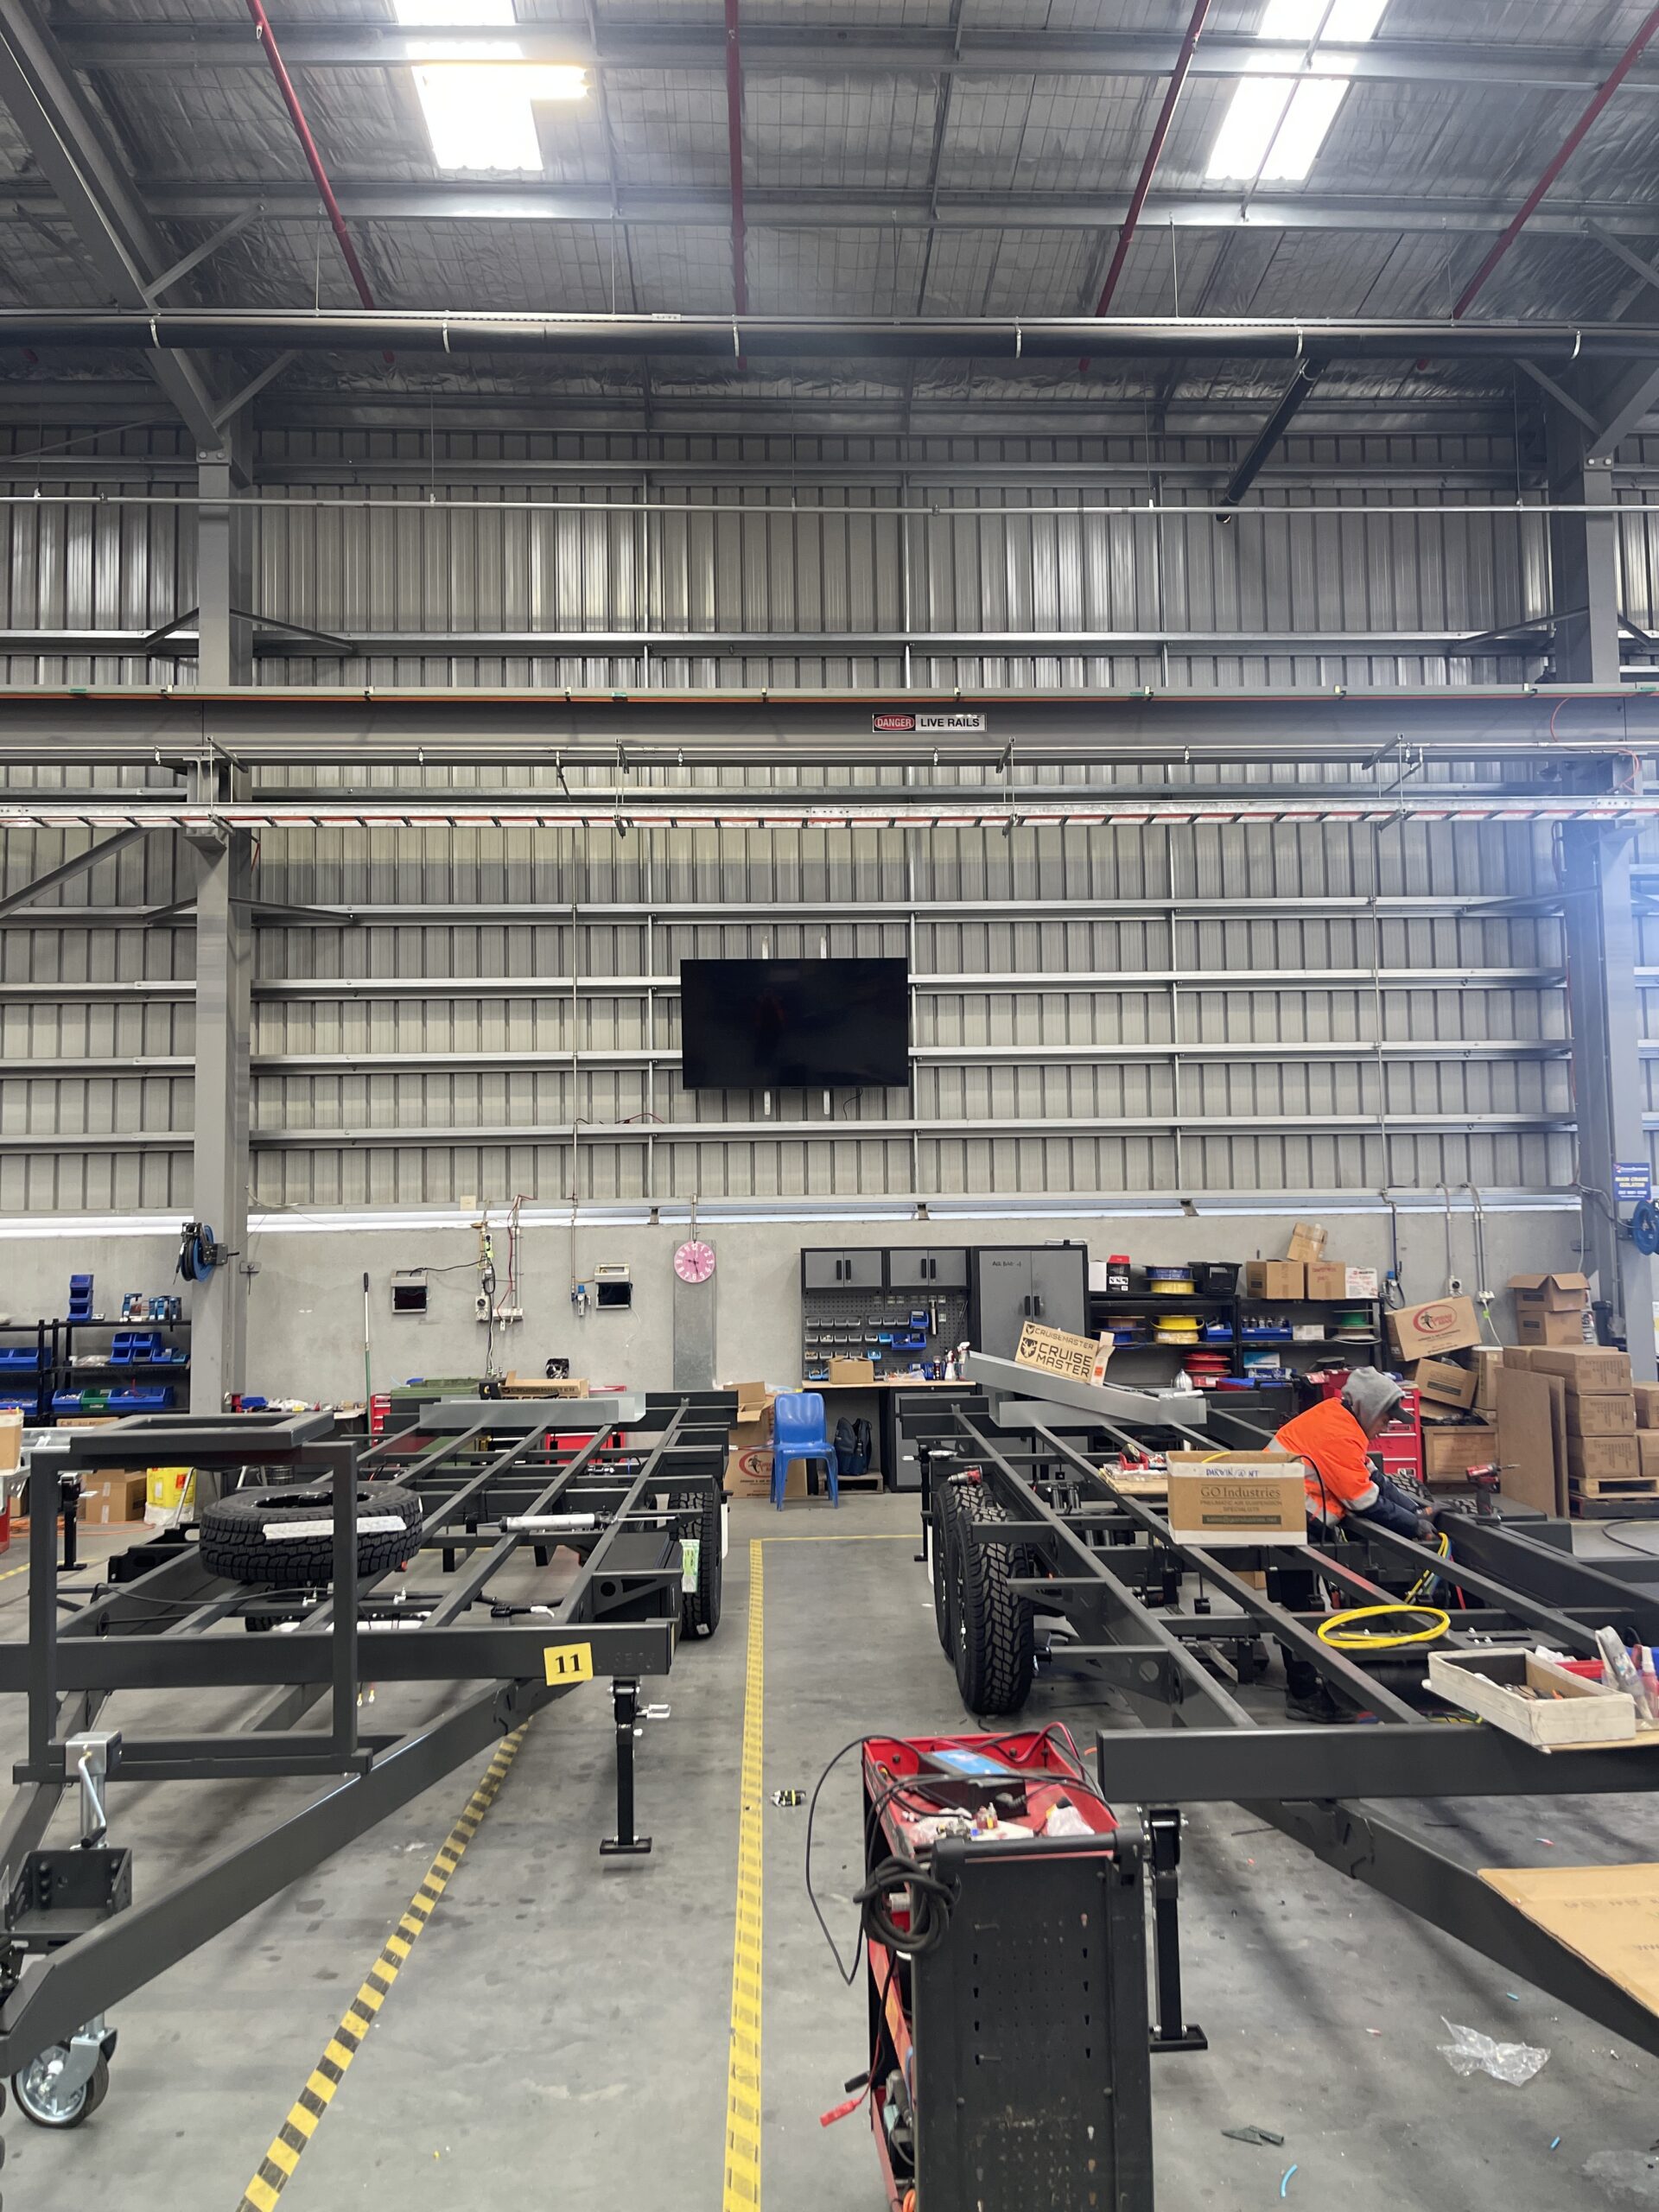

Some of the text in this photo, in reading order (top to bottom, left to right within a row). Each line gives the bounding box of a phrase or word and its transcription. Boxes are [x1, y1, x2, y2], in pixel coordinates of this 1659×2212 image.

[877, 718, 912, 728] DANGER
[920, 718, 980, 728] LIVE RAILS
[1034, 1327, 1094, 1351] CRUISEMASTER
[1036, 1353, 1090, 1377] MASTER
[1038, 1342, 1093, 1368] CRUISE
[1200, 1486, 1281, 1497] GO Industries
[555, 1653, 584, 1675] 11
